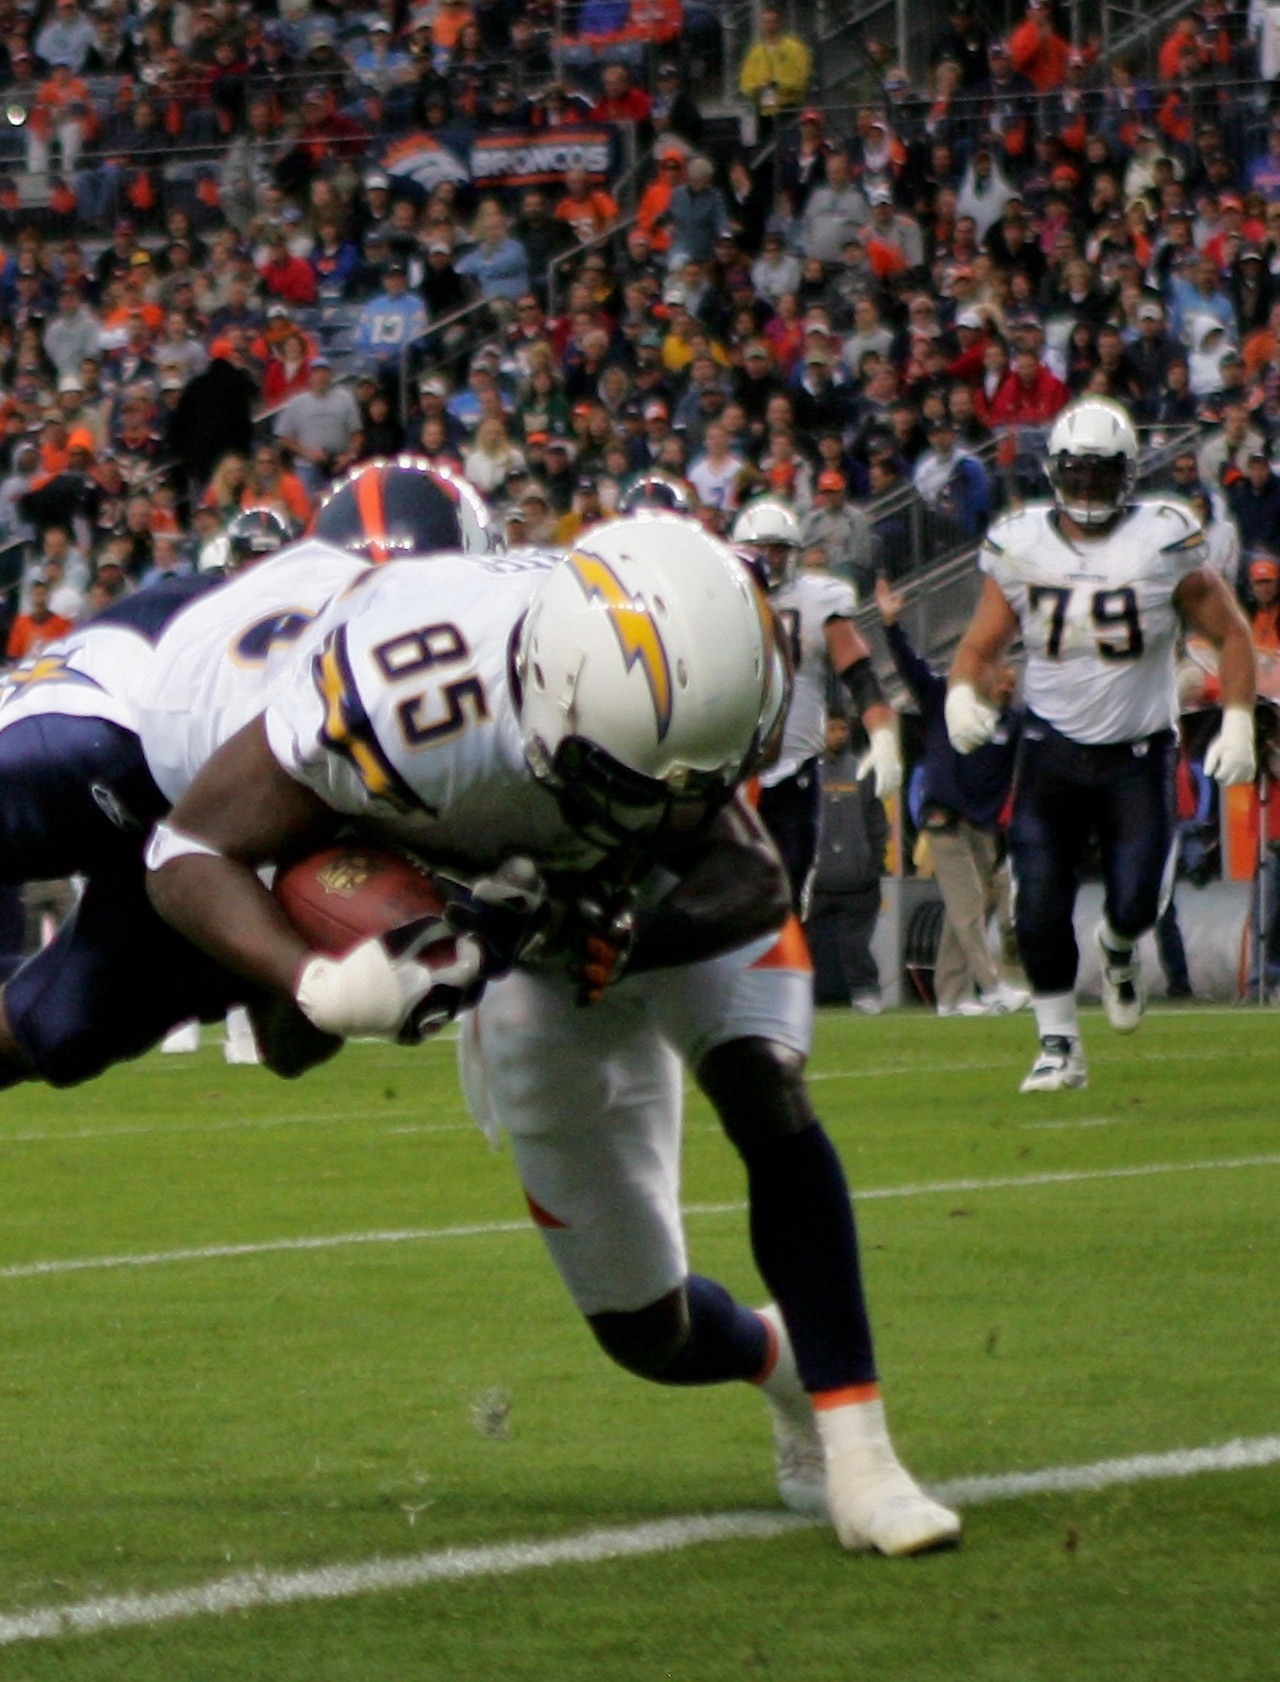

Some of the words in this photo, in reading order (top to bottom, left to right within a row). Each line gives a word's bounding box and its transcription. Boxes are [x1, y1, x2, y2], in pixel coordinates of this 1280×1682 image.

[471, 143, 610, 178] BRONCOS
[1027, 584, 1146, 664] 79
[370, 621, 493, 755] 85
